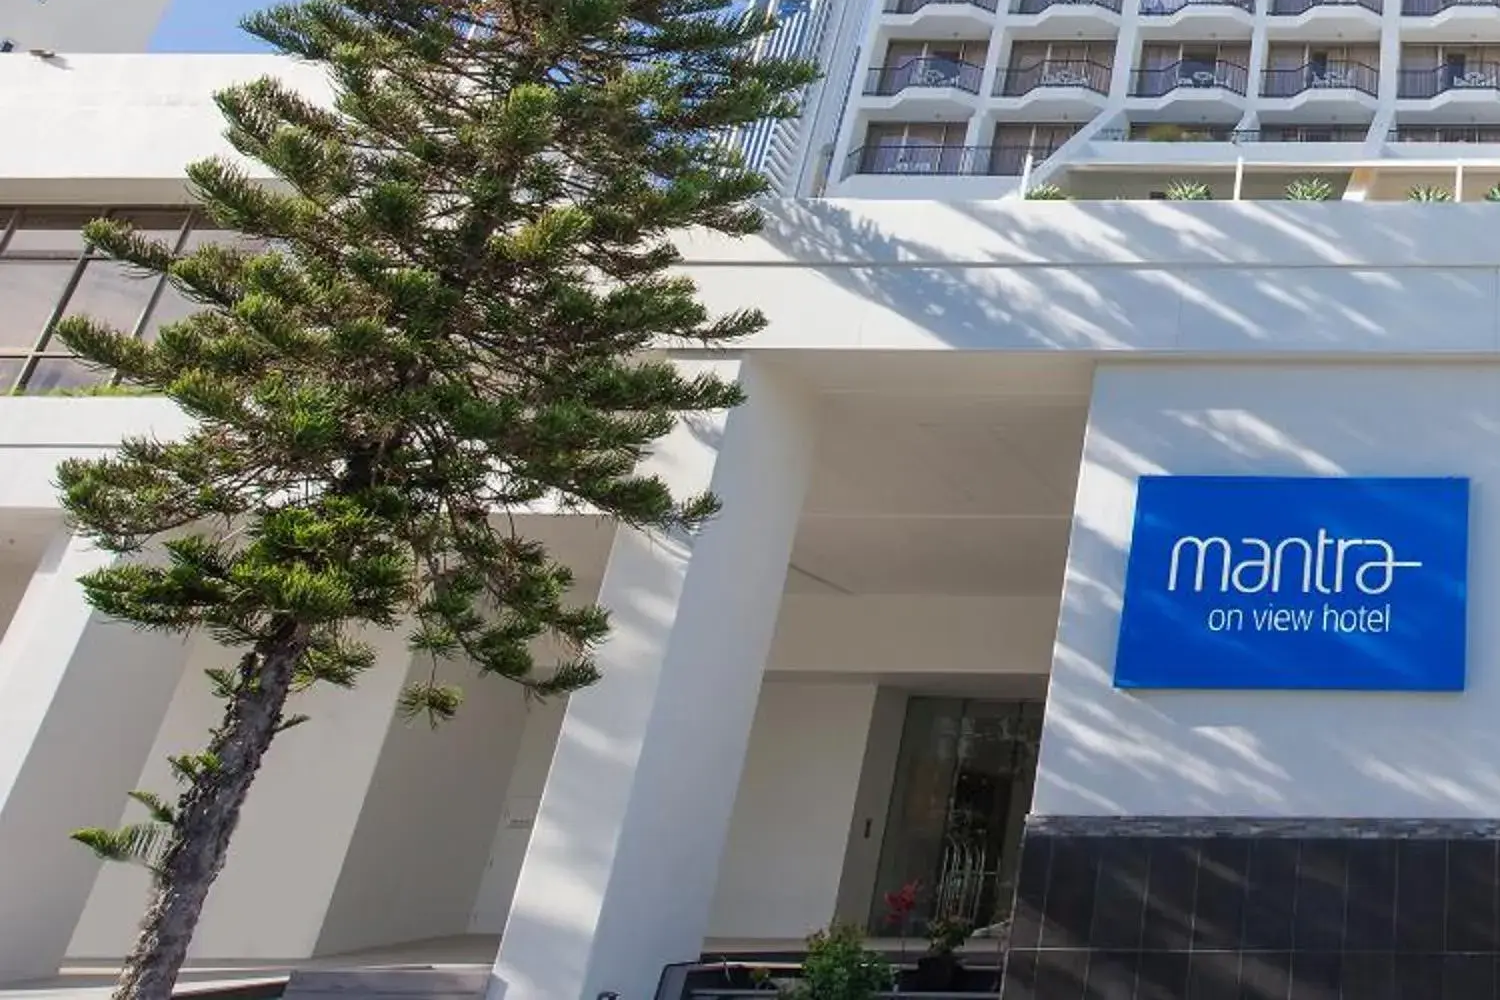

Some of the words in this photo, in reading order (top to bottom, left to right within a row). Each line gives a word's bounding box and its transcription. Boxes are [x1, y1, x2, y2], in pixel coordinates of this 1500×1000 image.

[1167, 528, 1423, 595] mantra
[1208, 608, 1243, 632] on
[1253, 603, 1314, 632] view
[1322, 603, 1391, 633] hotel
